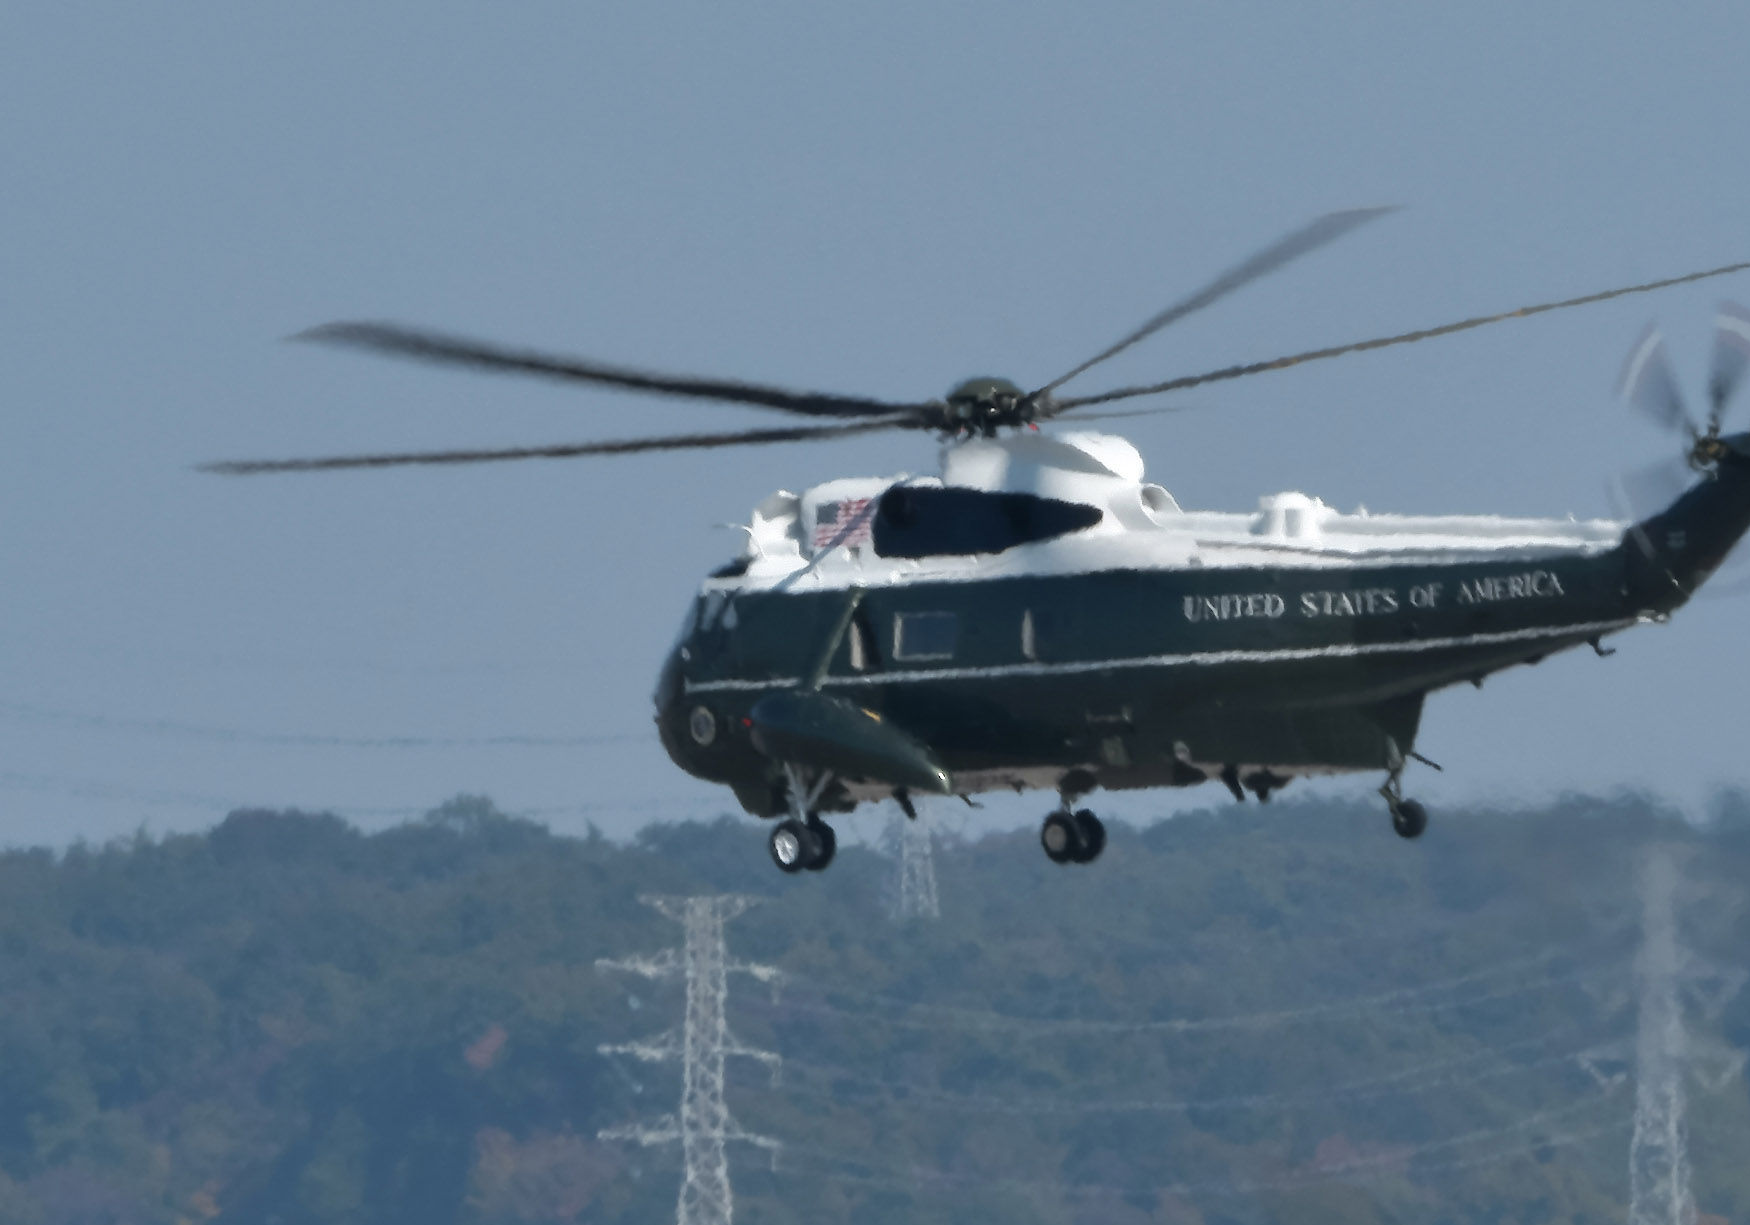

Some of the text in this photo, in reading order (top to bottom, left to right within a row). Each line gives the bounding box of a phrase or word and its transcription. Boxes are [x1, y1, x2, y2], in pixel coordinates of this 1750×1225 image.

[1184, 569, 1565, 623] UNITED STATES OF AMERICA
